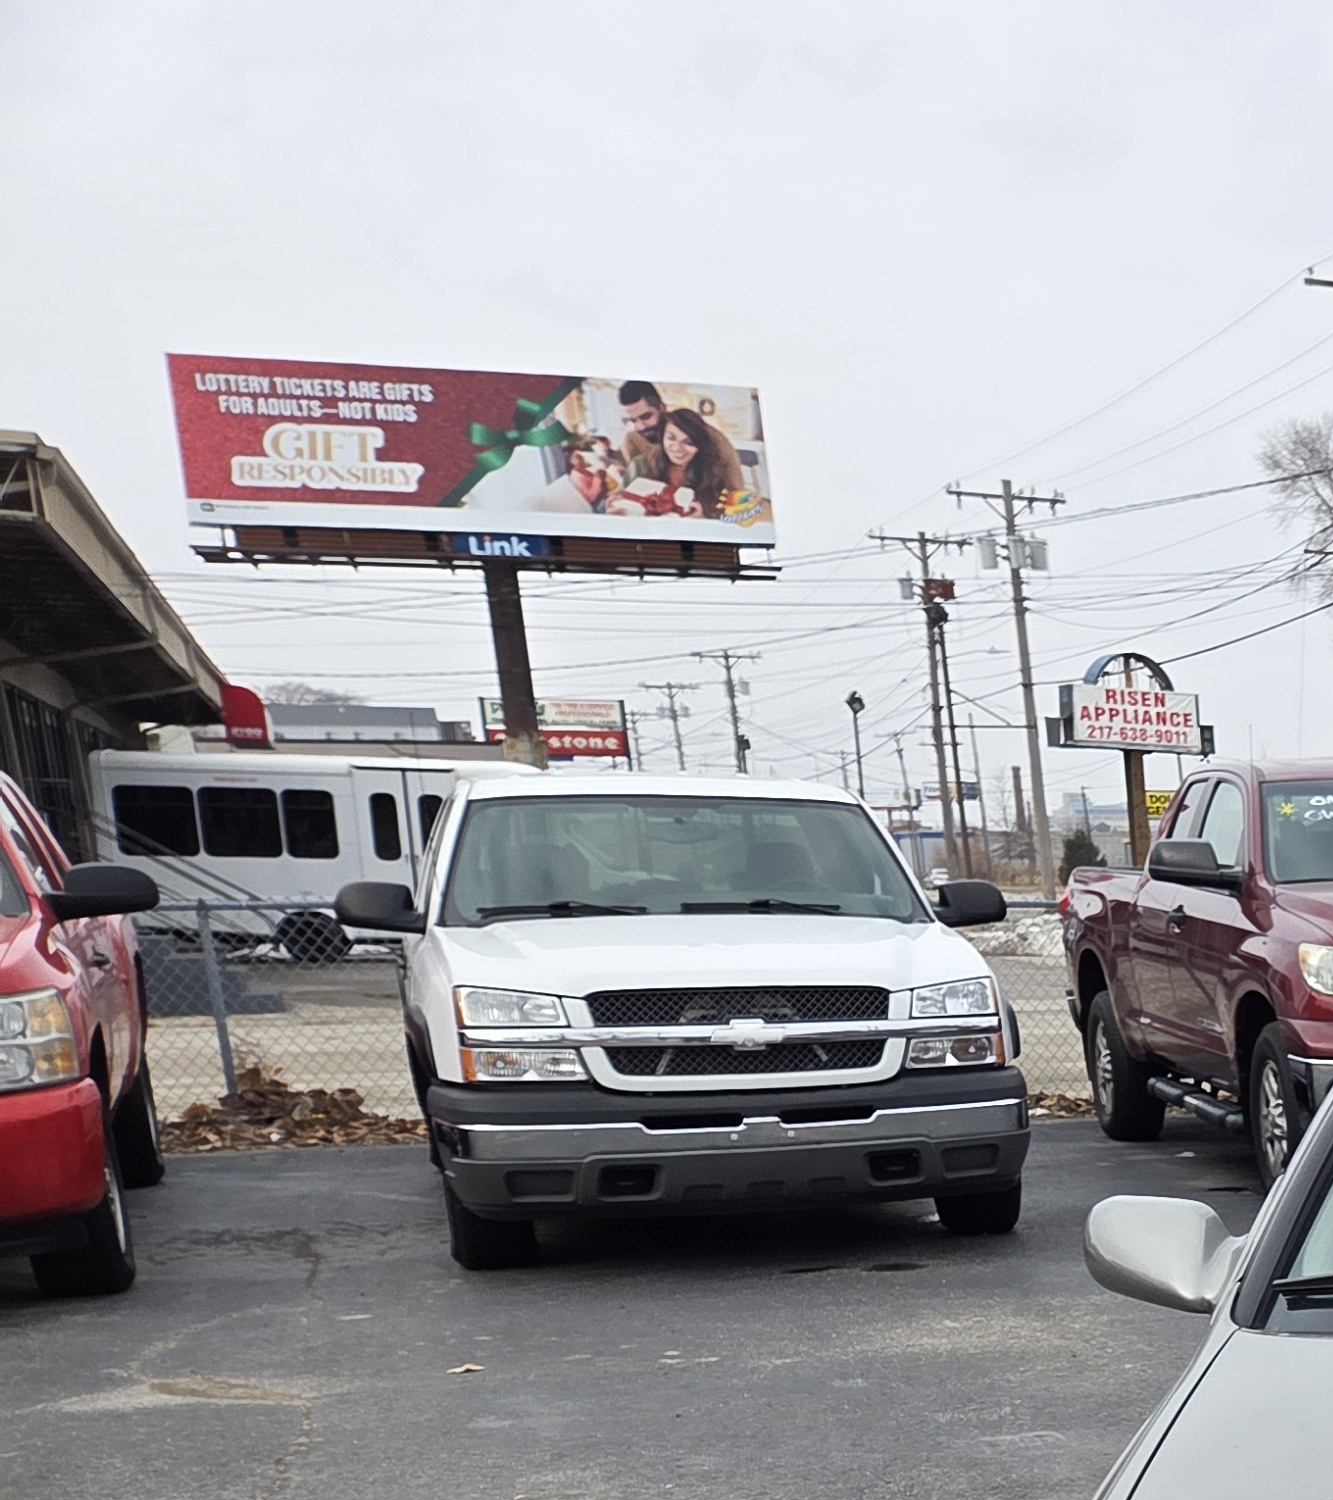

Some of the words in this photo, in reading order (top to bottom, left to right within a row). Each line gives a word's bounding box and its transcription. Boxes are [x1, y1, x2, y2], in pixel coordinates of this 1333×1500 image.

[194, 373, 270, 394] LOTTERY
[272, 377, 346, 398] TICKETS
[349, 380, 381, 400] ARE
[383, 383, 434, 402] GIFTS
[218, 395, 254, 414] FOR
[375, 404, 418, 422] KIDS
[270, 428, 379, 462] GIFT
[238, 462, 418, 487] RESPONSIBLY
[468, 535, 533, 557] Link
[1106, 689, 1166, 708] RISEN
[1080, 706, 1194, 728] APPLIANCE
